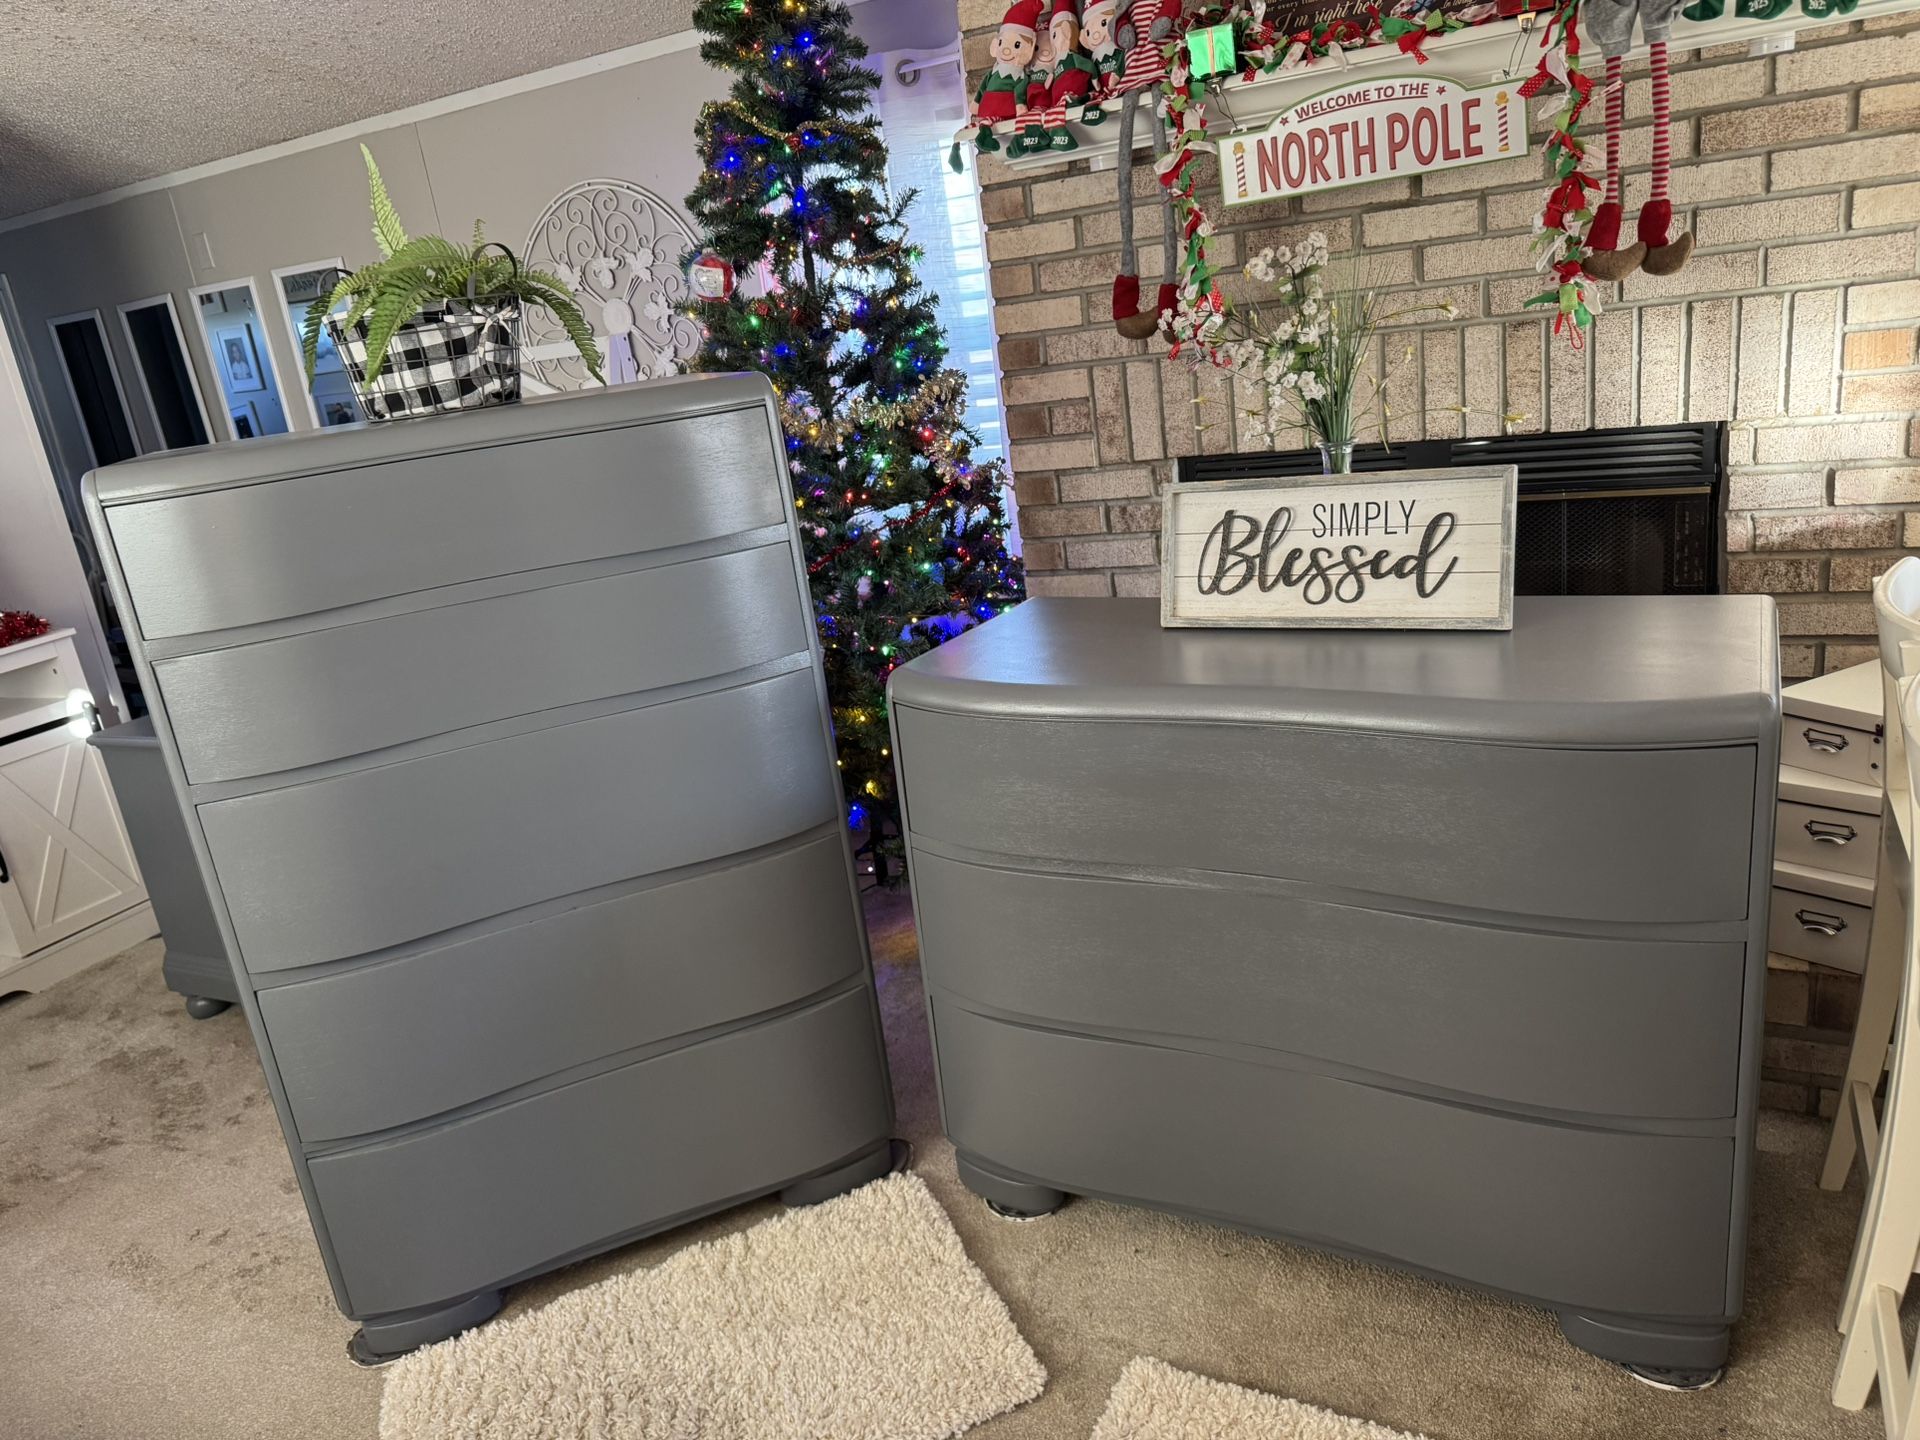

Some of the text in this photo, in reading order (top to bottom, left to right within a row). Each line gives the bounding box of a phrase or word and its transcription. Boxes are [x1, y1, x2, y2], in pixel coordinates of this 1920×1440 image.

[1277, 1, 1299, 10] every
[1314, 1, 1352, 28] right
[1294, 82, 1430, 120] WELCOME TO THE
[1084, 110, 1100, 120] 2023
[1023, 136, 1039, 146] 2023
[1052, 136, 1069, 145] 2023
[1256, 97, 1484, 193] NORTH POLE
[1312, 499, 1417, 539] SIMPLY
[1197, 506, 1459, 605] Blessed
